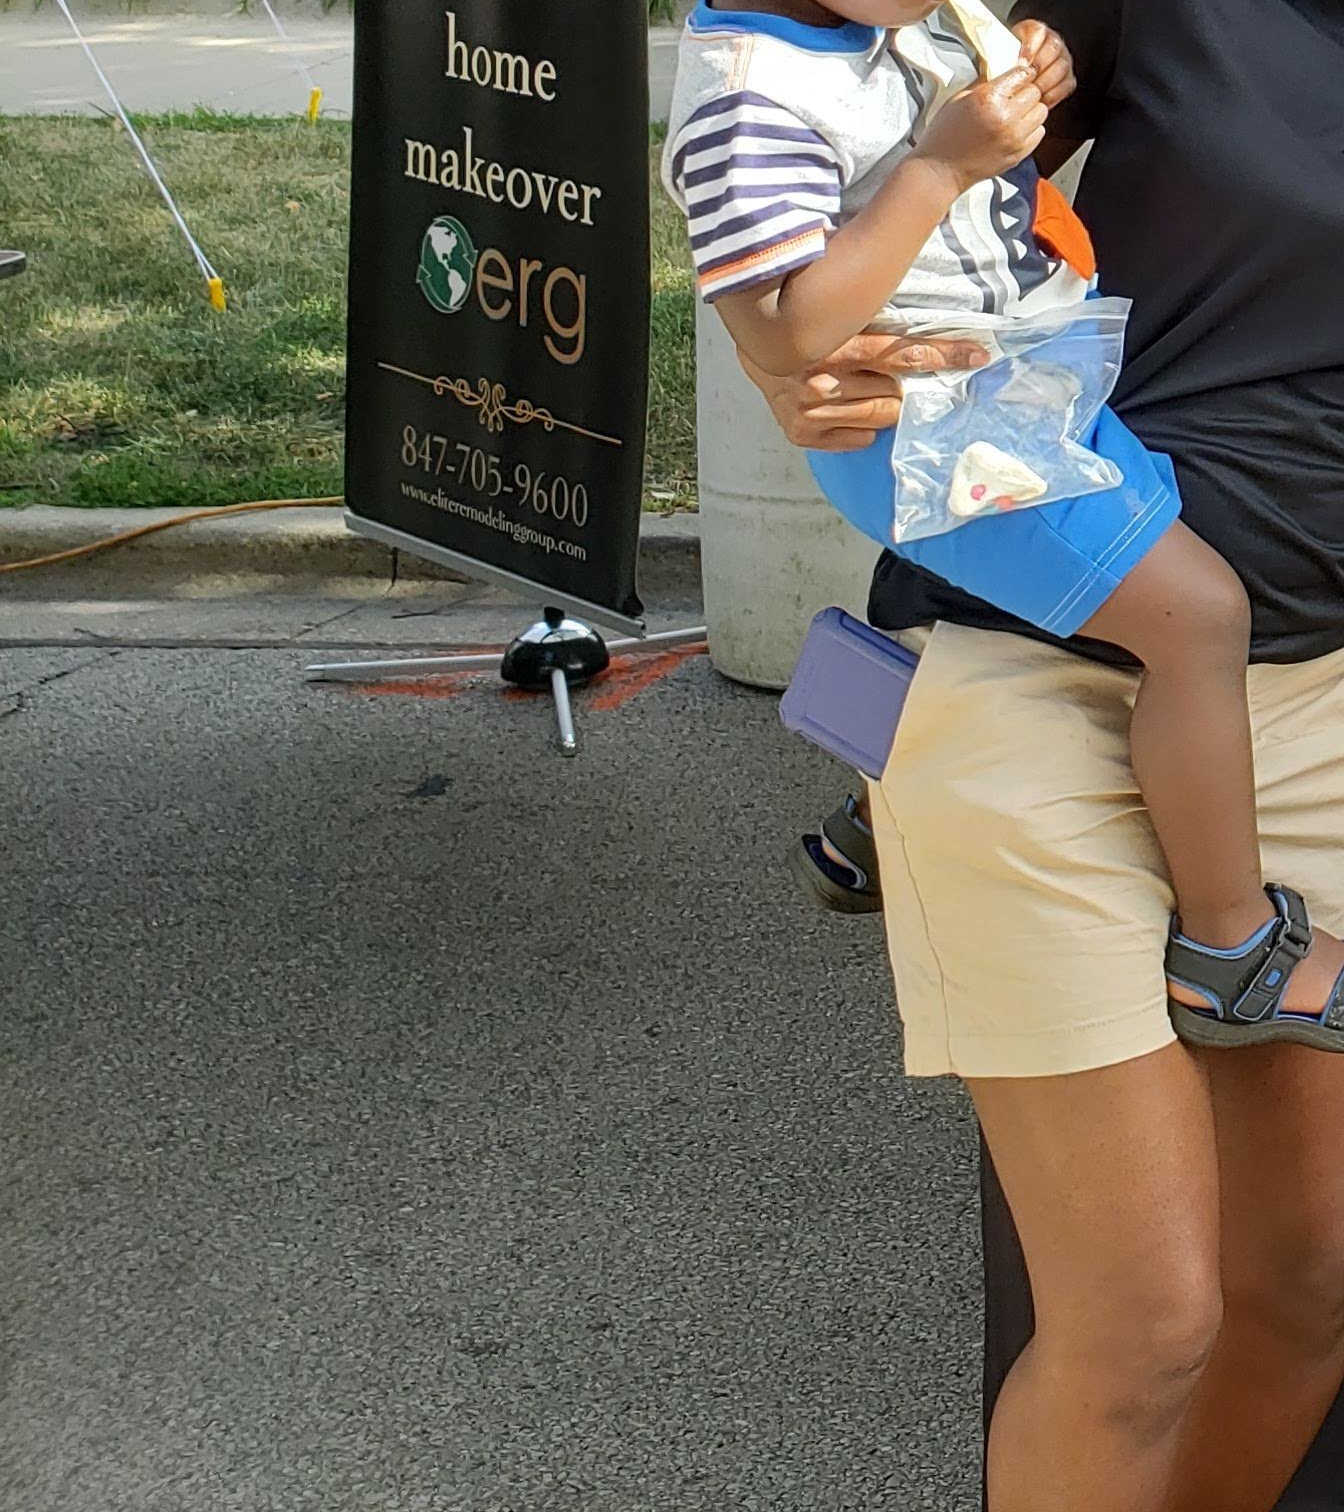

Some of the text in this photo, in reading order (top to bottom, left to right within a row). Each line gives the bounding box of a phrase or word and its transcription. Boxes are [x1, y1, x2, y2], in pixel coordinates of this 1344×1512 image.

[444, 10, 558, 102] home
[404, 126, 602, 227] makeover
[475, 247, 587, 366] erg
[400, 480, 588, 562] www.eliteremodelinggroup.com
[401, 424, 590, 529] 847-705-9600
